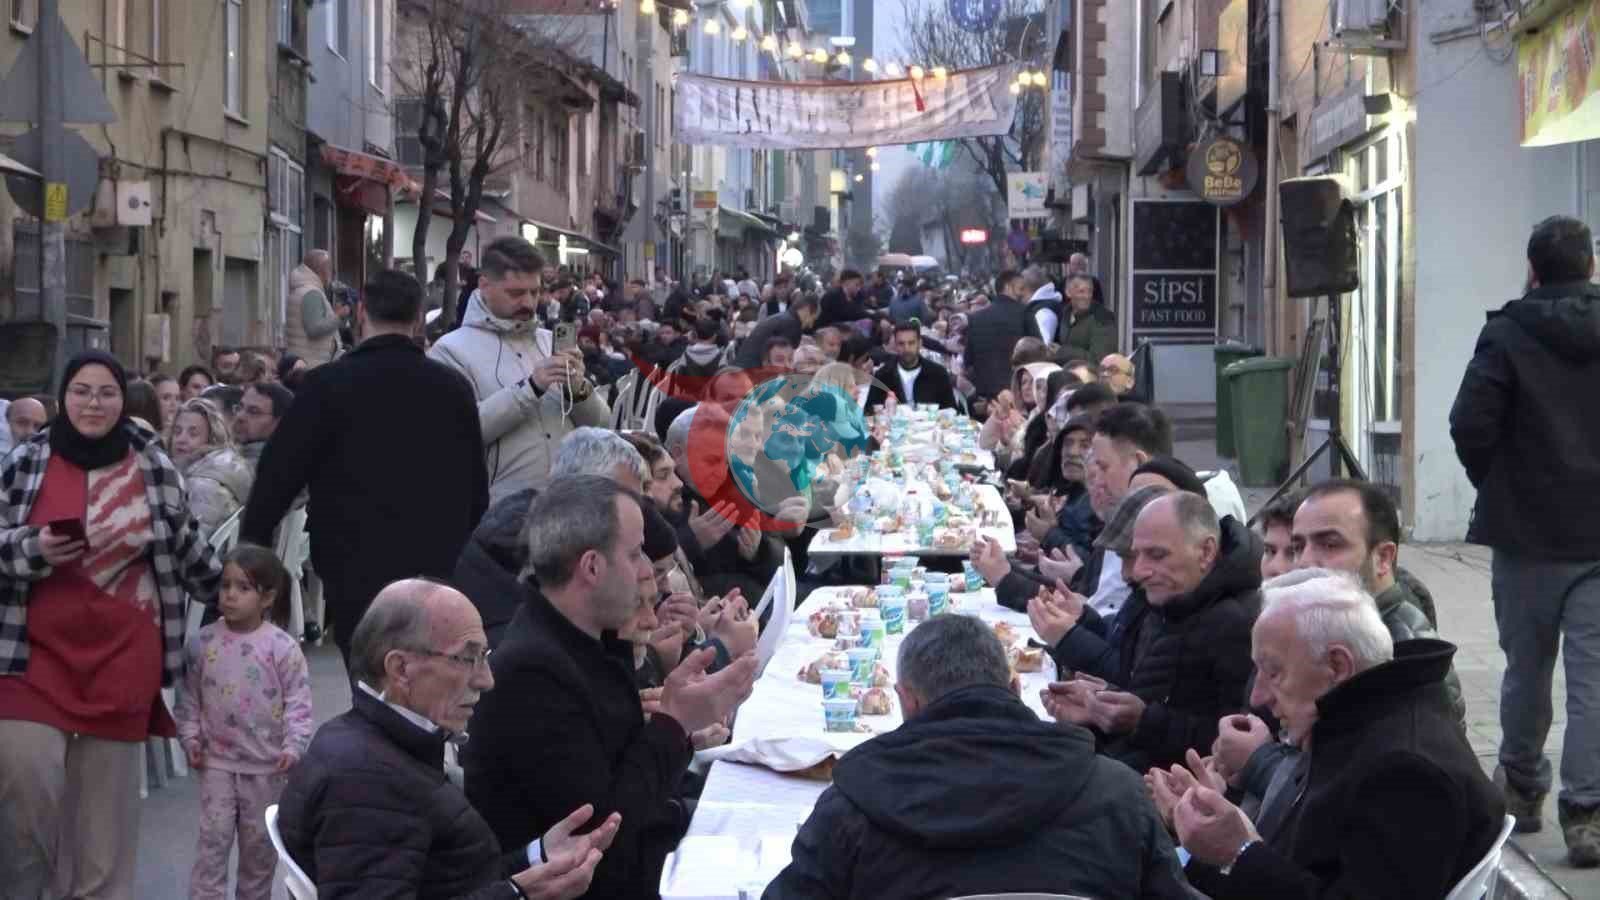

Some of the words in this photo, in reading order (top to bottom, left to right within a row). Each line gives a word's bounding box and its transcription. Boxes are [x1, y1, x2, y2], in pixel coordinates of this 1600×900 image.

[1143, 277, 1204, 304] SİPSİ
[1141, 309, 1170, 322] FAST
[1174, 309, 1207, 322] FOOD
